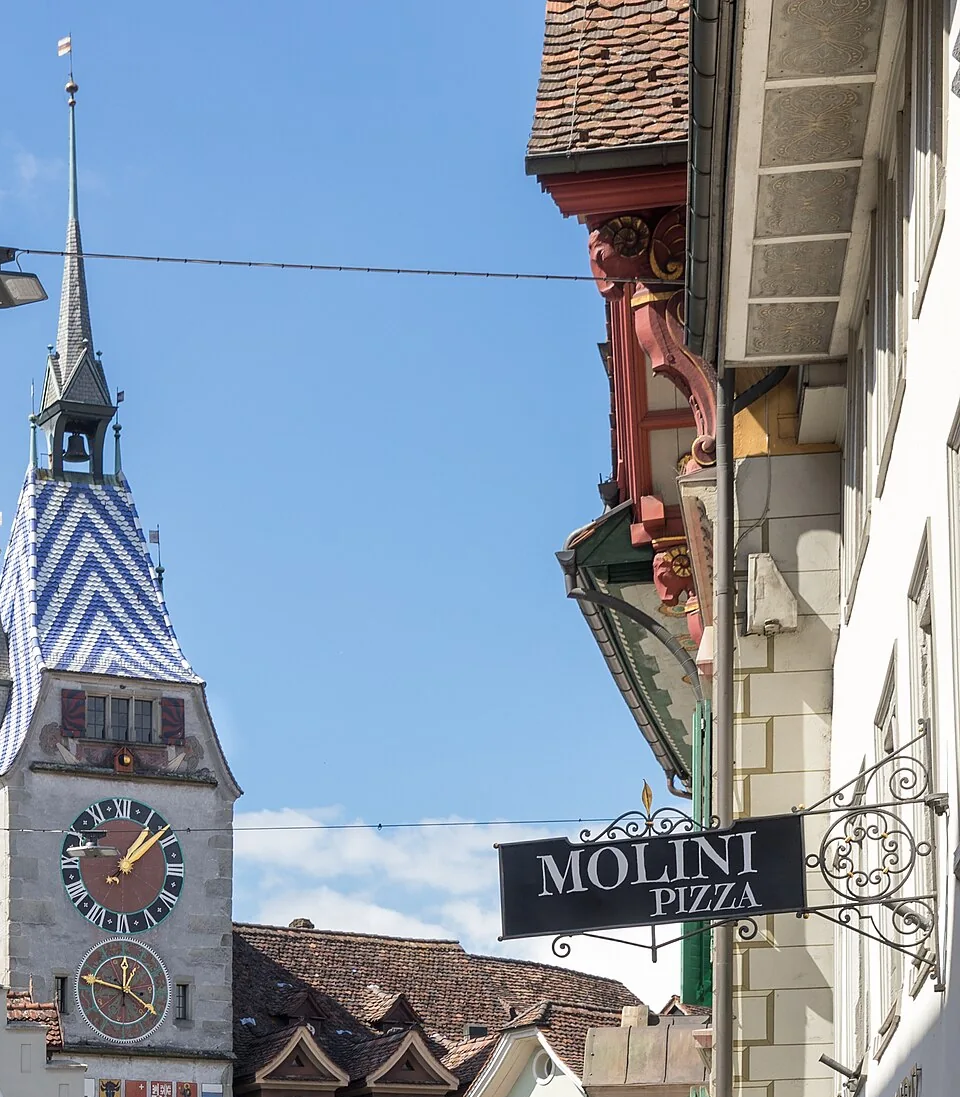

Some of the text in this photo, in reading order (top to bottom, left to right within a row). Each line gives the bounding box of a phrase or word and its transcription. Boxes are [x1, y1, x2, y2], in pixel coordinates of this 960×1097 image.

[160, 833, 178, 848] II
[166, 863, 184, 877] III
[536, 831, 758, 897] MOLINI
[649, 882, 762, 917] PIZZA
